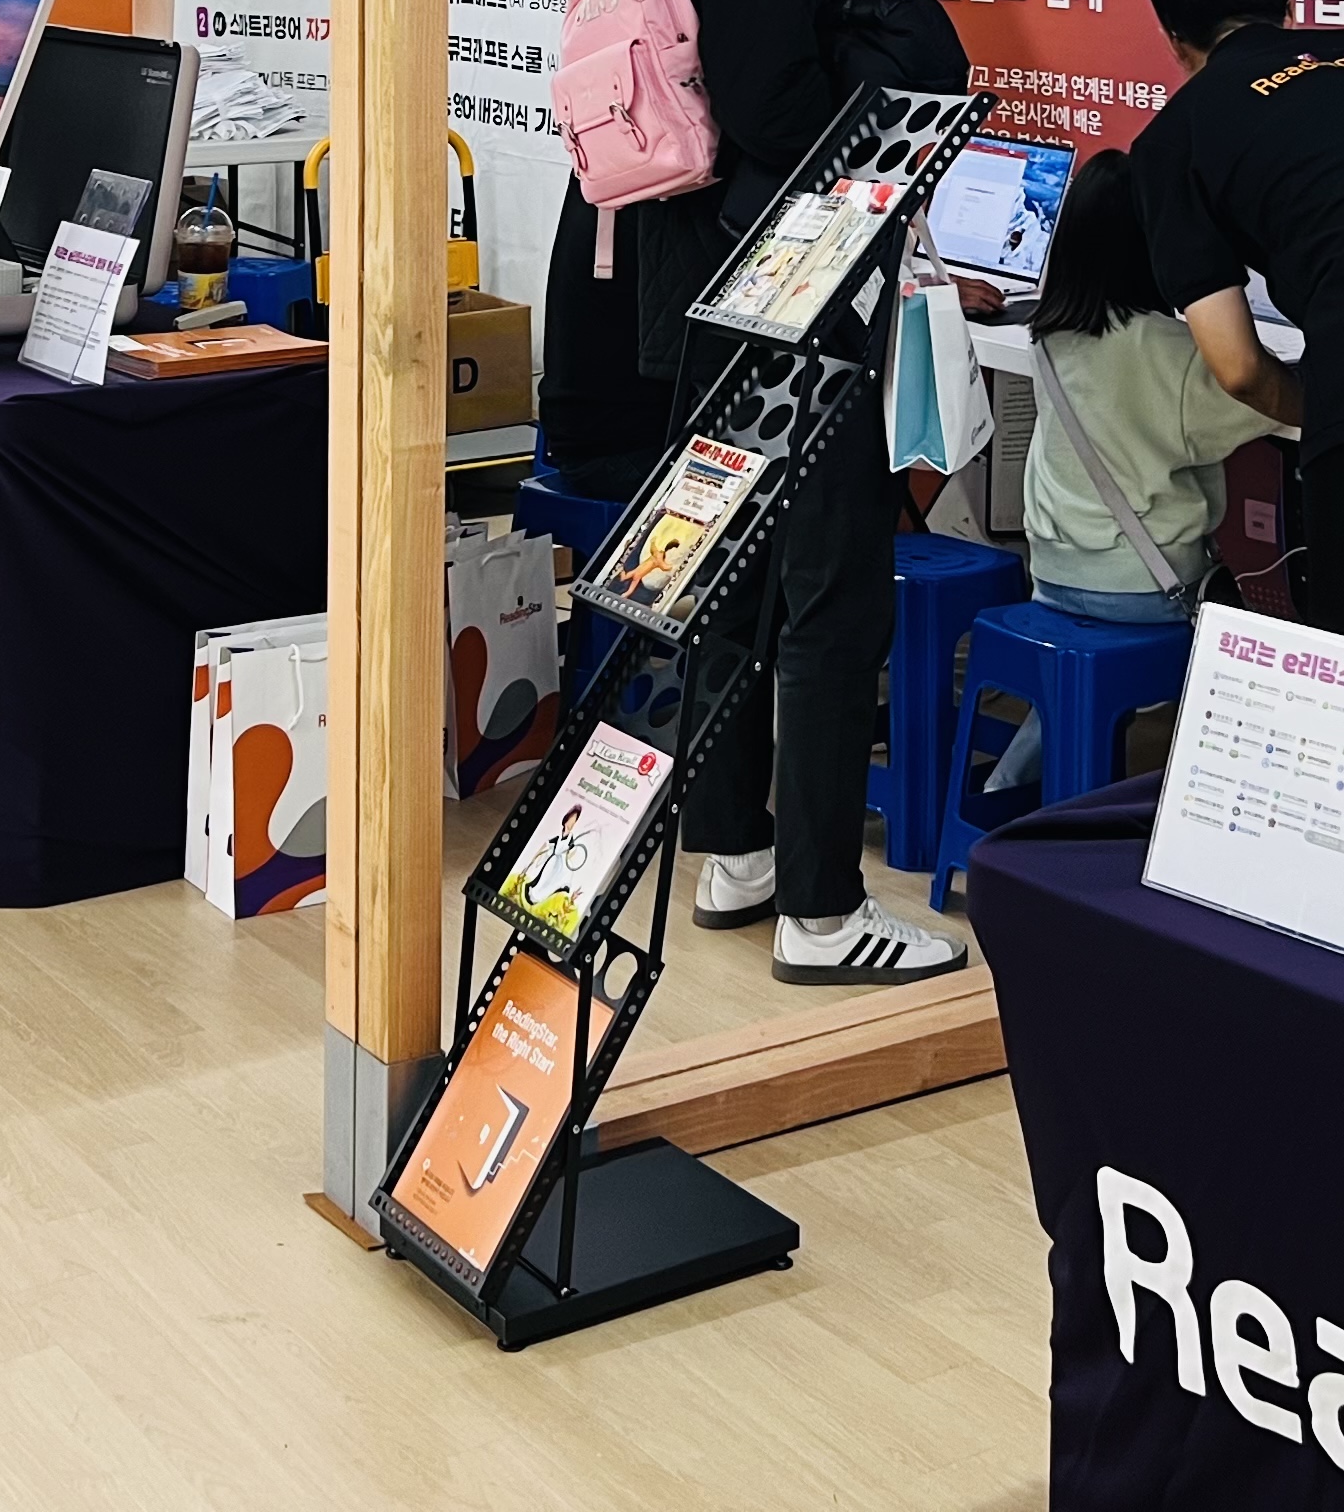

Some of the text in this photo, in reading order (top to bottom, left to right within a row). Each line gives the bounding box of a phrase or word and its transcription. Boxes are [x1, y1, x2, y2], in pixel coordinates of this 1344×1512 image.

[296, 73, 330, 91] 프로그
[994, 68, 1067, 98] 교육과정과
[1071, 75, 1114, 105] 연계된
[1118, 81, 1167, 111] 내용을
[996, 99, 1102, 136] 수업시간에 배운
[1218, 631, 1276, 668] 학교는
[492, 1023, 554, 1076] the Right Start
